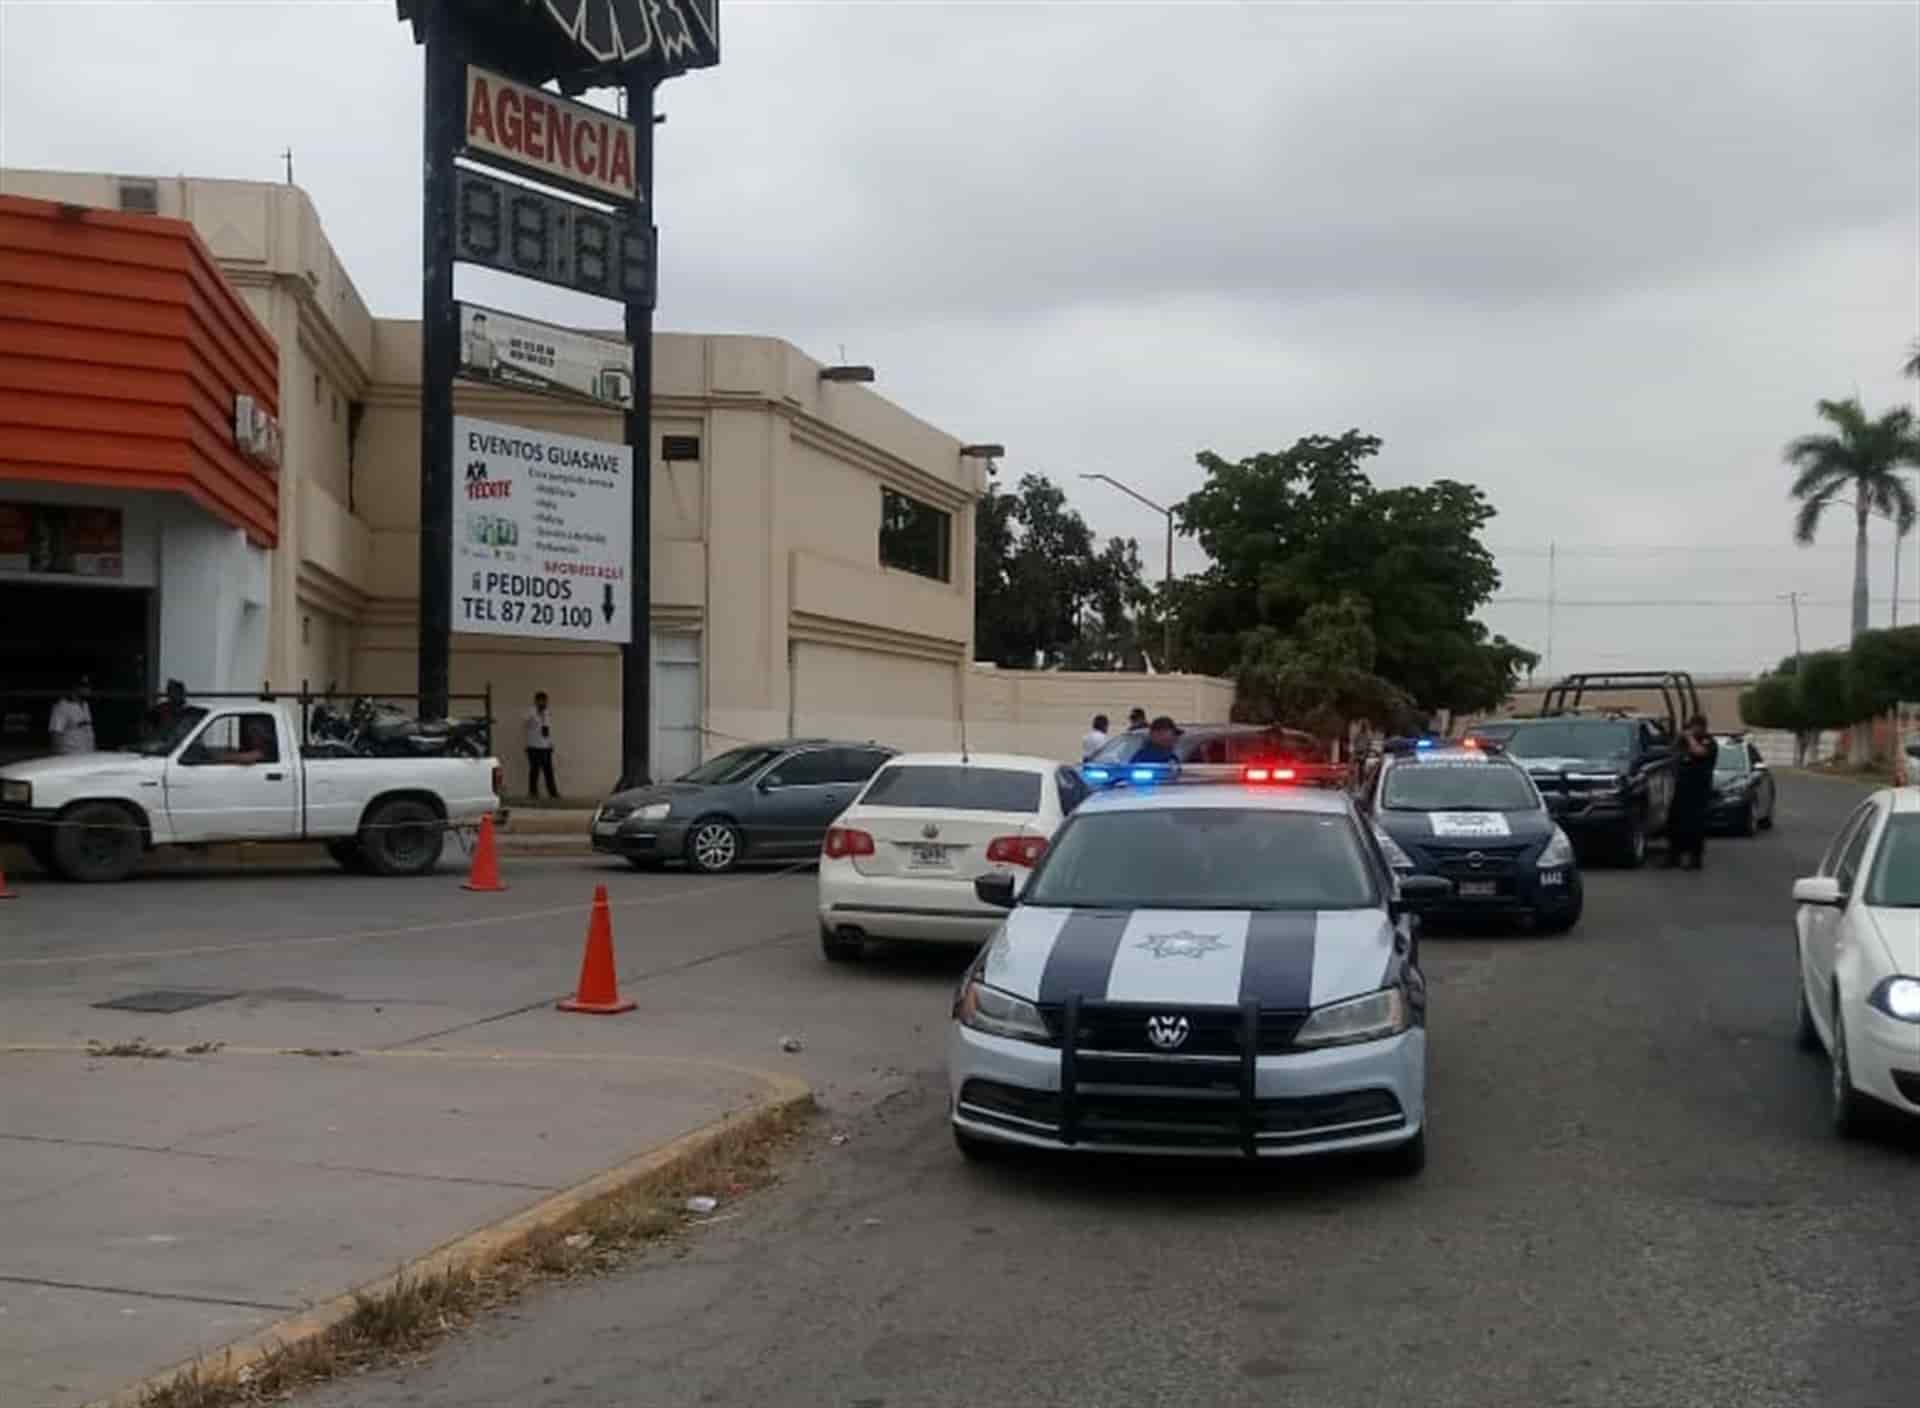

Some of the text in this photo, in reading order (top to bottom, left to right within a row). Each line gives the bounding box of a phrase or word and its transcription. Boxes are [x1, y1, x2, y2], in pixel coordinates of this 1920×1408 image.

[468, 76, 633, 190] AGENCIA
[469, 432, 620, 474] EVENTOS GUASAVE
[465, 480, 513, 500] TECATE
[486, 572, 572, 600] PEDIDOS
[462, 597, 593, 628] TEL 87 20 100
